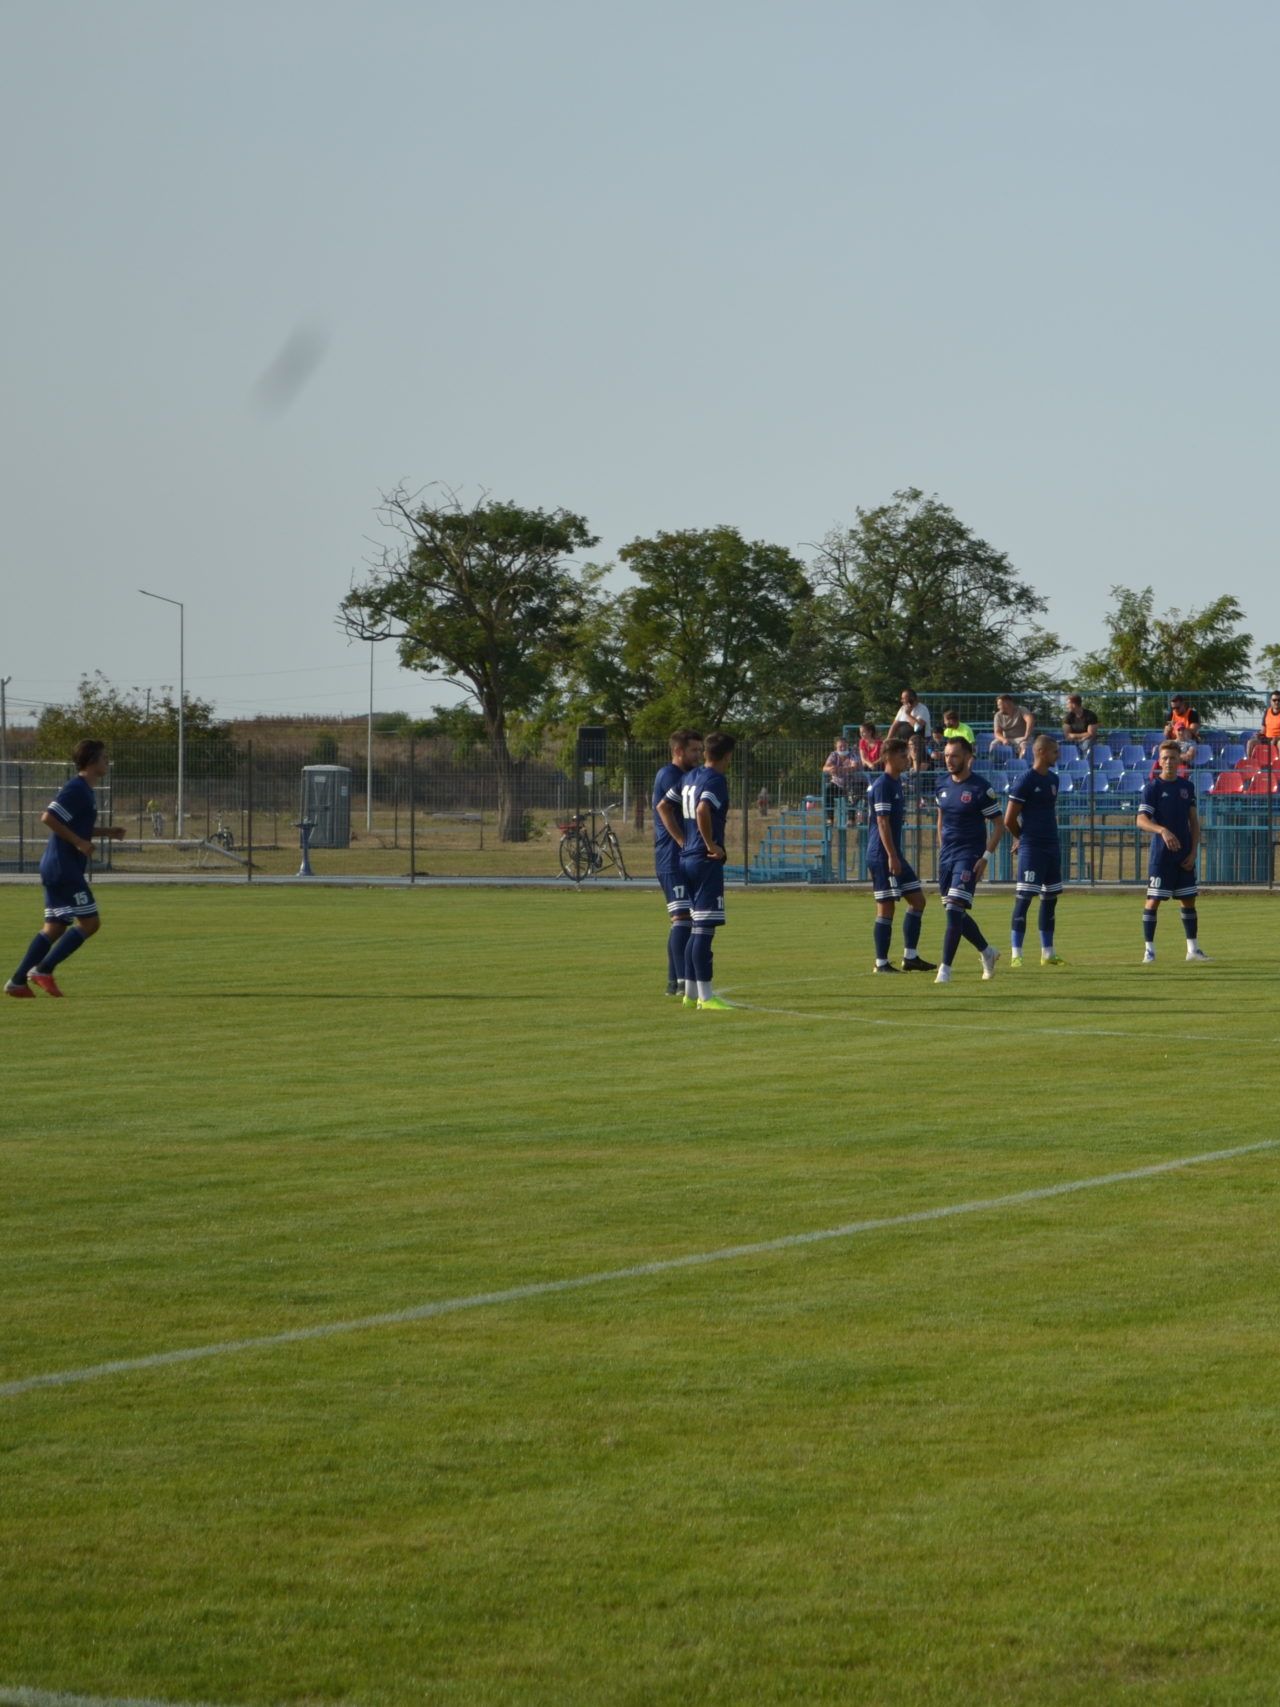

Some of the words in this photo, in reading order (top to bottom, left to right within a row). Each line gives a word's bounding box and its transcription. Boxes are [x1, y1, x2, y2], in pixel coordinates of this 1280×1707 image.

[681, 784, 696, 819] 11
[1024, 870, 1035, 882] 18
[1150, 876, 1161, 888] 20
[73, 891, 89, 906] 15
[672, 885, 685, 899] 17
